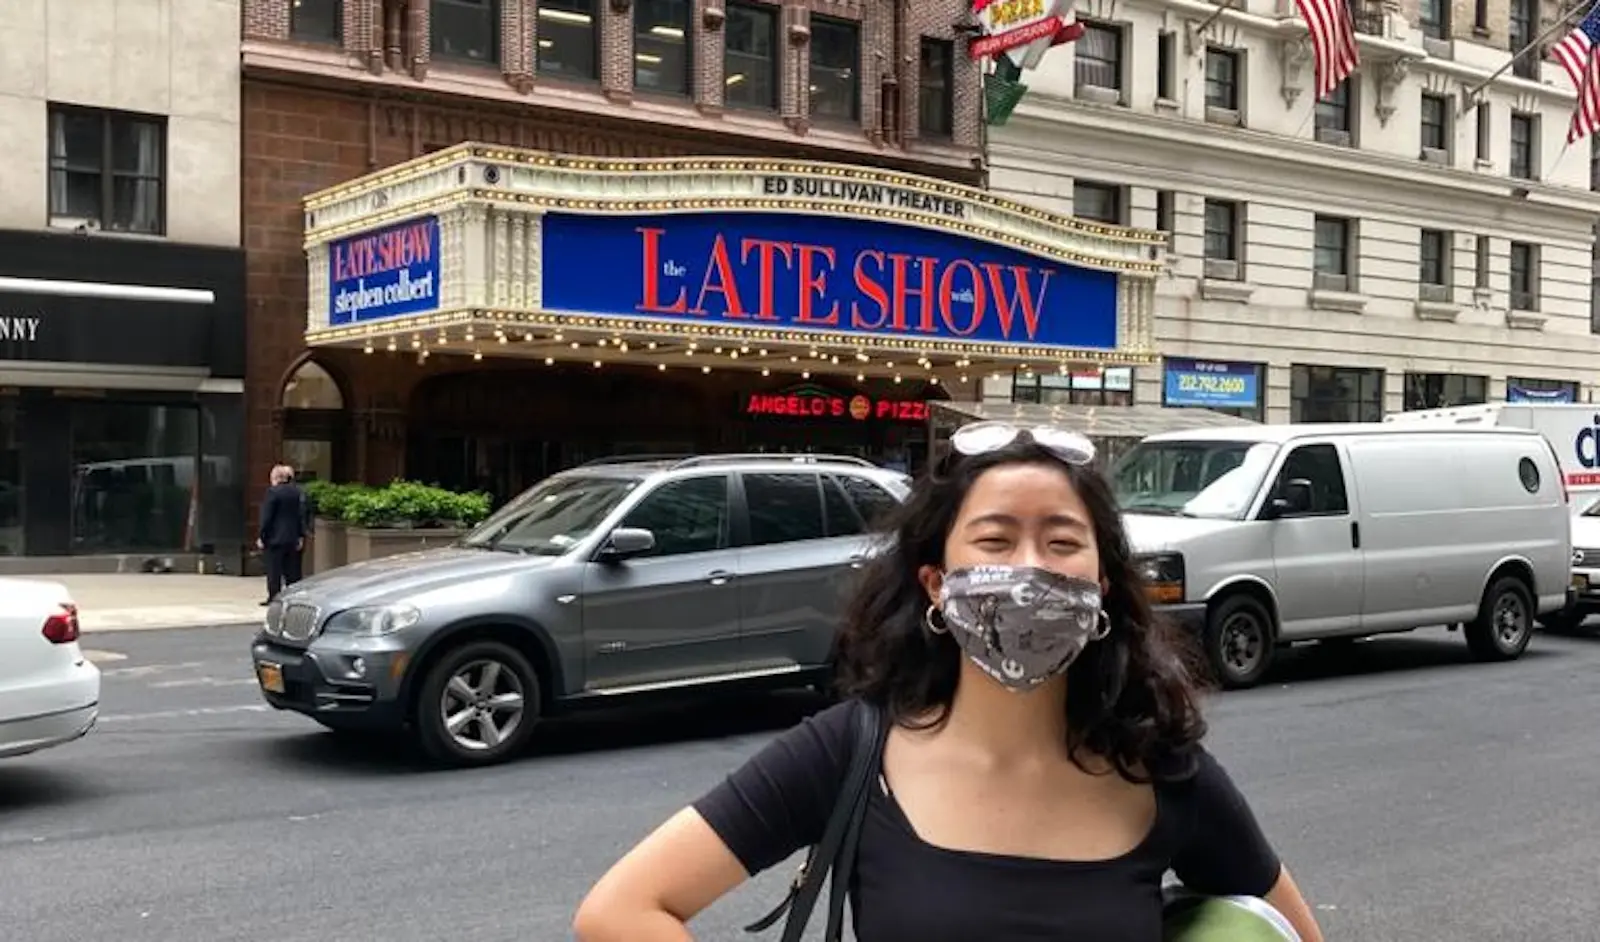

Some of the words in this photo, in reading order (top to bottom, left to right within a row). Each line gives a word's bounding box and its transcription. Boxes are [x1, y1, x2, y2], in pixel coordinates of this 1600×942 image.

[764, 177, 788, 194] ED
[794, 180, 881, 202] SULLIVAN
[886, 188, 964, 218] THEATER
[334, 236, 379, 282] LATE
[379, 221, 434, 271] SHOW
[663, 259, 686, 277] the
[335, 278, 383, 322] stephen
[385, 268, 433, 305] colbert
[635, 226, 839, 325] LATE
[852, 249, 1056, 340] SHOW
[747, 394, 844, 416] ANGELO'S
